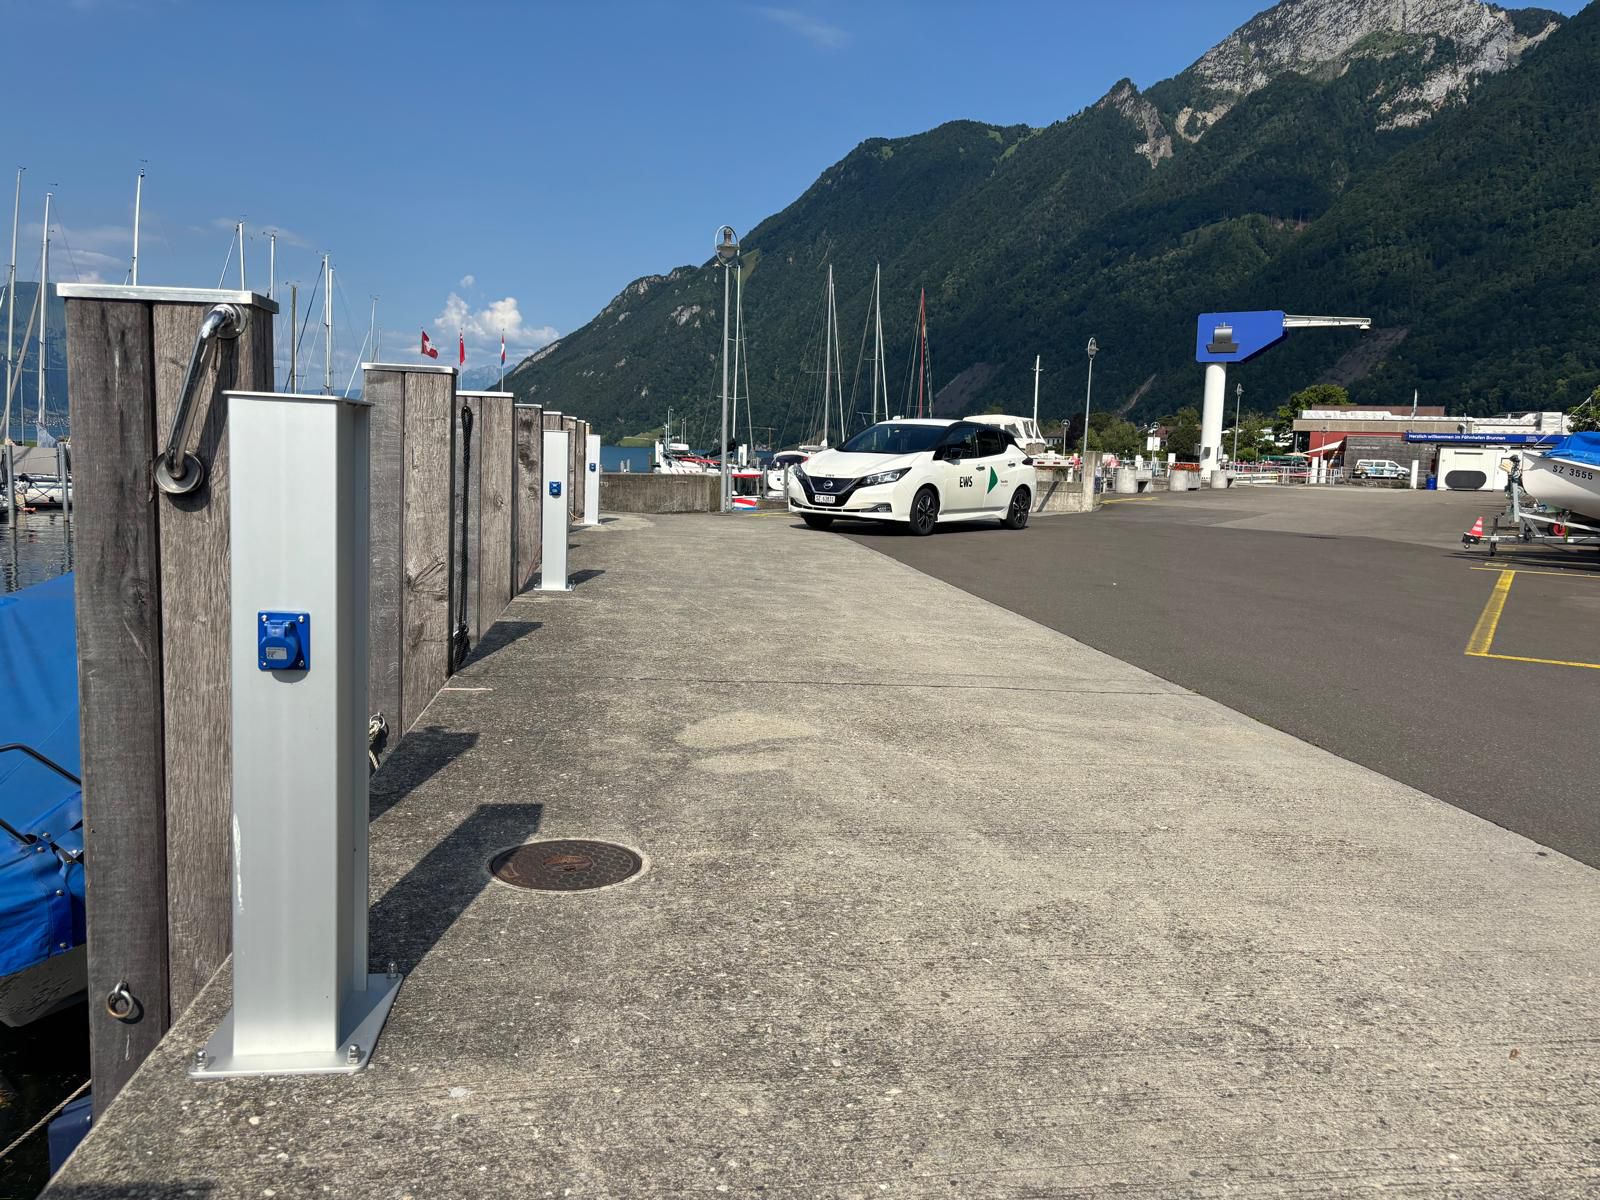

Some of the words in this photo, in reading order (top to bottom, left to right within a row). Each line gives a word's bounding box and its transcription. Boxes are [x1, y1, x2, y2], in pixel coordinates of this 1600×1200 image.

[1552, 464, 1564, 474] SZ
[1569, 469, 1593, 480] 3555
[959, 475, 973, 488] EWS
